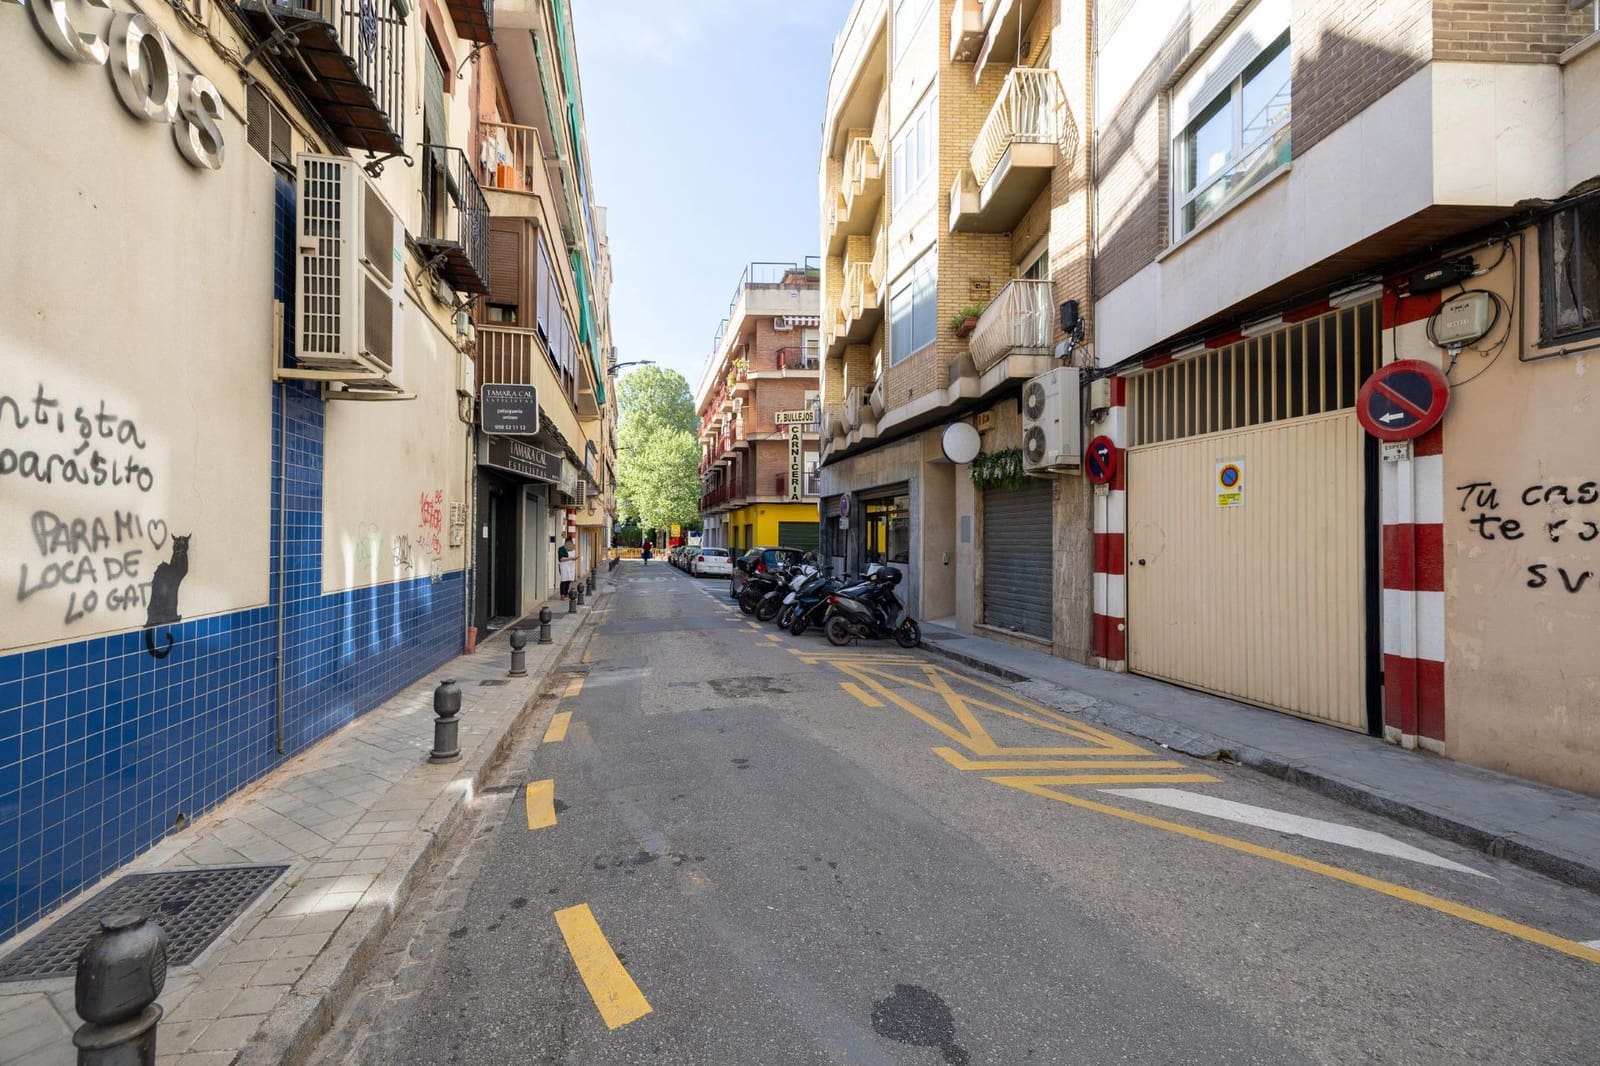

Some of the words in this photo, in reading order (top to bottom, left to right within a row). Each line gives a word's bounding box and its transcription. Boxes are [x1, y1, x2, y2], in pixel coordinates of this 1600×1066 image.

[776, 414, 783, 423] F.
[784, 412, 814, 422] BULLEJOS
[510, 441, 536, 461] TAMARA
[791, 426, 799, 500] CARNICERIA
[31, 510, 110, 555] PARA
[114, 510, 143, 542] MI
[1469, 513, 1525, 540] te
[17, 556, 97, 601] LOCA
[104, 550, 143, 581] DE
